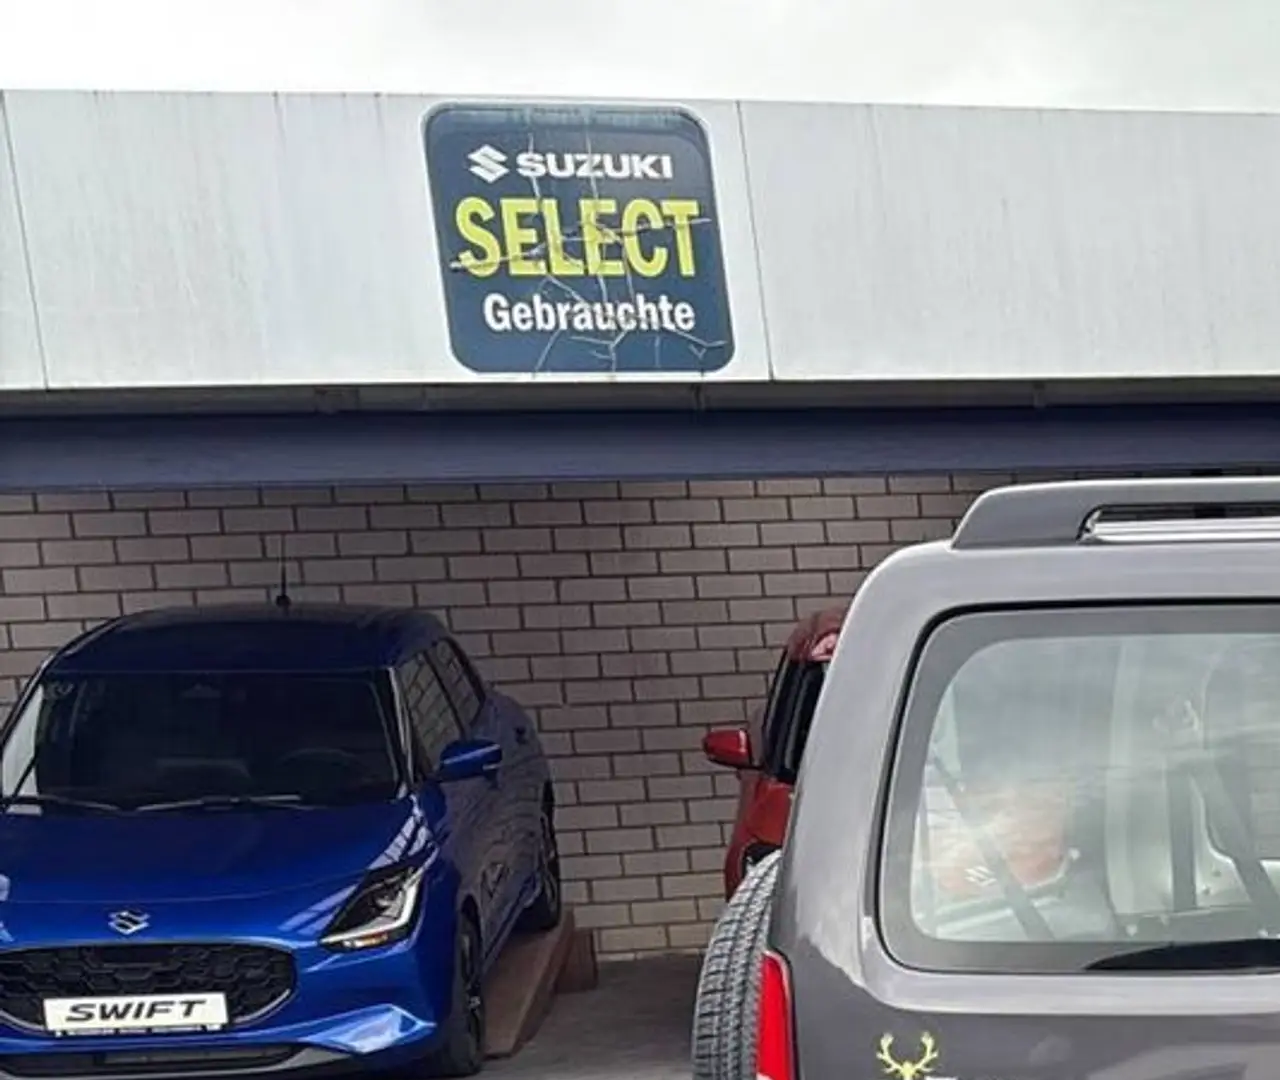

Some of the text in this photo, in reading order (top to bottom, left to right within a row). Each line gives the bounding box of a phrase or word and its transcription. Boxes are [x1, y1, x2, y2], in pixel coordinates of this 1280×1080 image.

[517, 153, 673, 179] SUZUKI
[455, 196, 700, 277] SELECT
[483, 293, 696, 332] Gebrauchte
[66, 1000, 206, 1022] SWIFT
